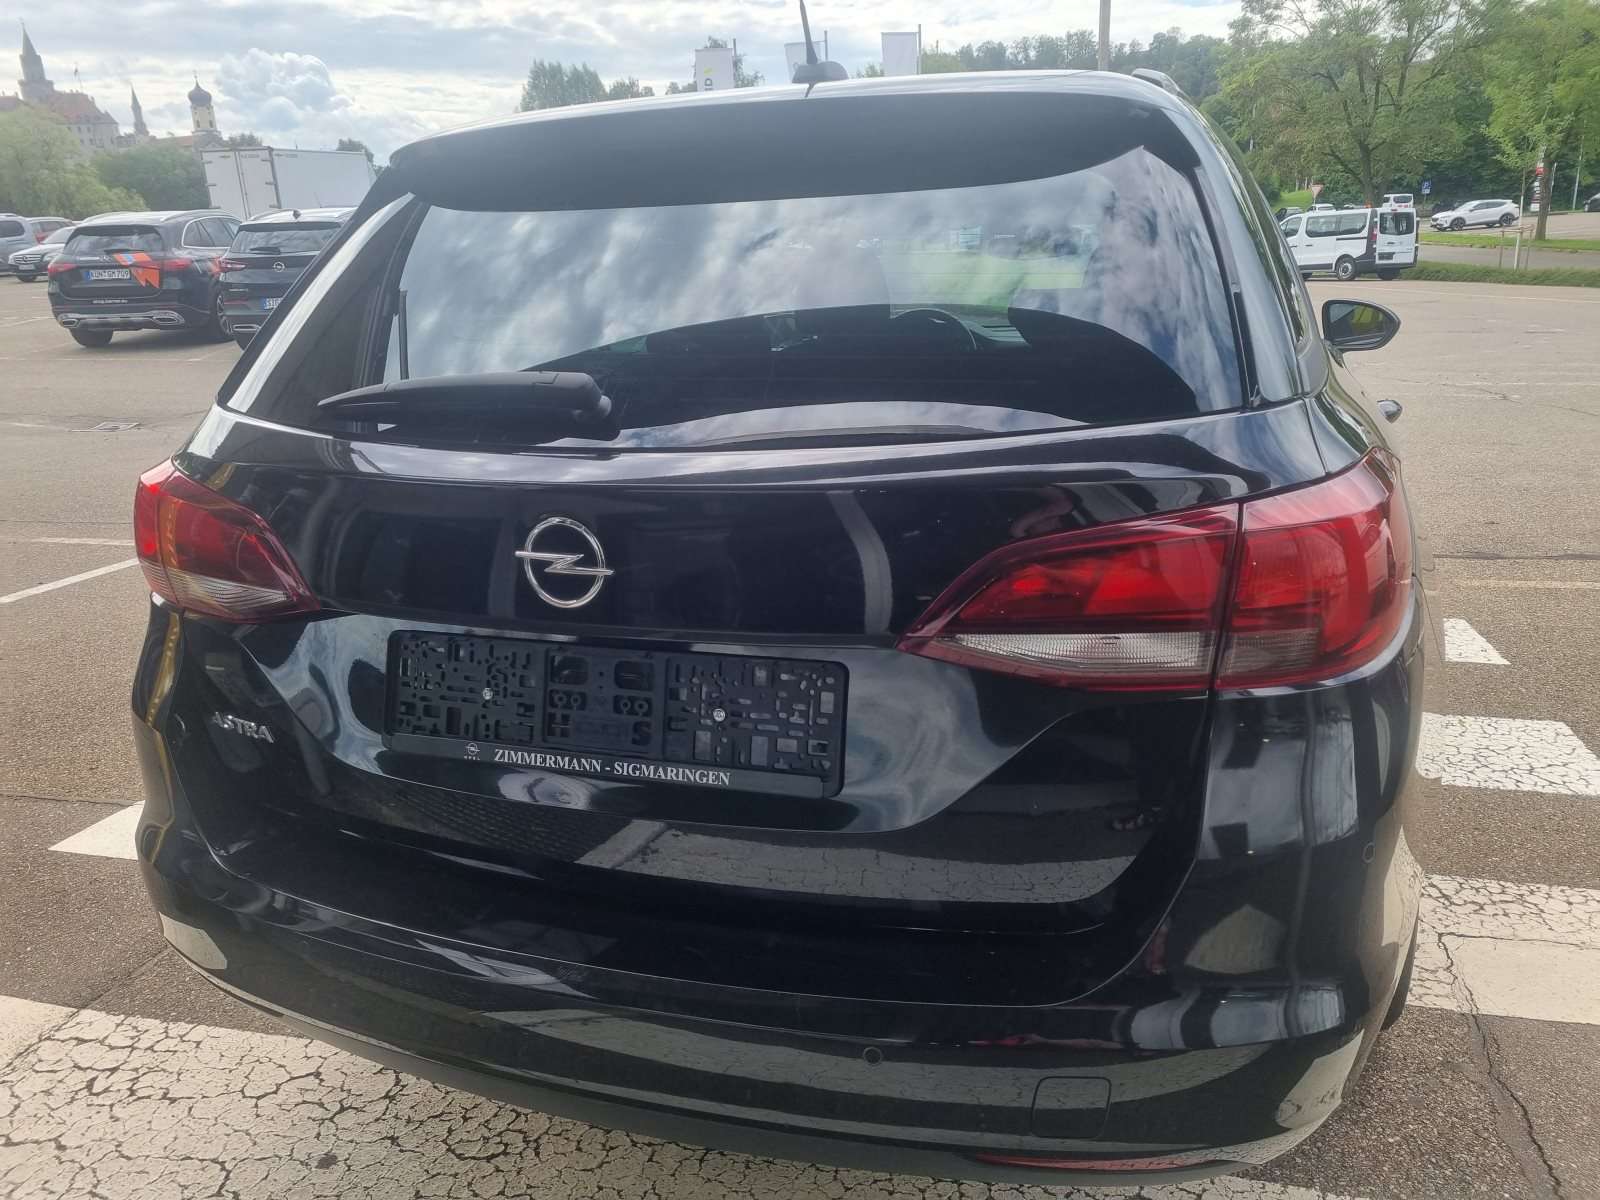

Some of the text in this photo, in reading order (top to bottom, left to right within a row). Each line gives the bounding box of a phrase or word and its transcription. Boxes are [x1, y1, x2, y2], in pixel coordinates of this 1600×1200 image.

[212, 711, 274, 743] ASTRA
[494, 749, 601, 773] ZIMMERMANN
[613, 762, 731, 786] SIGMARINGEN
